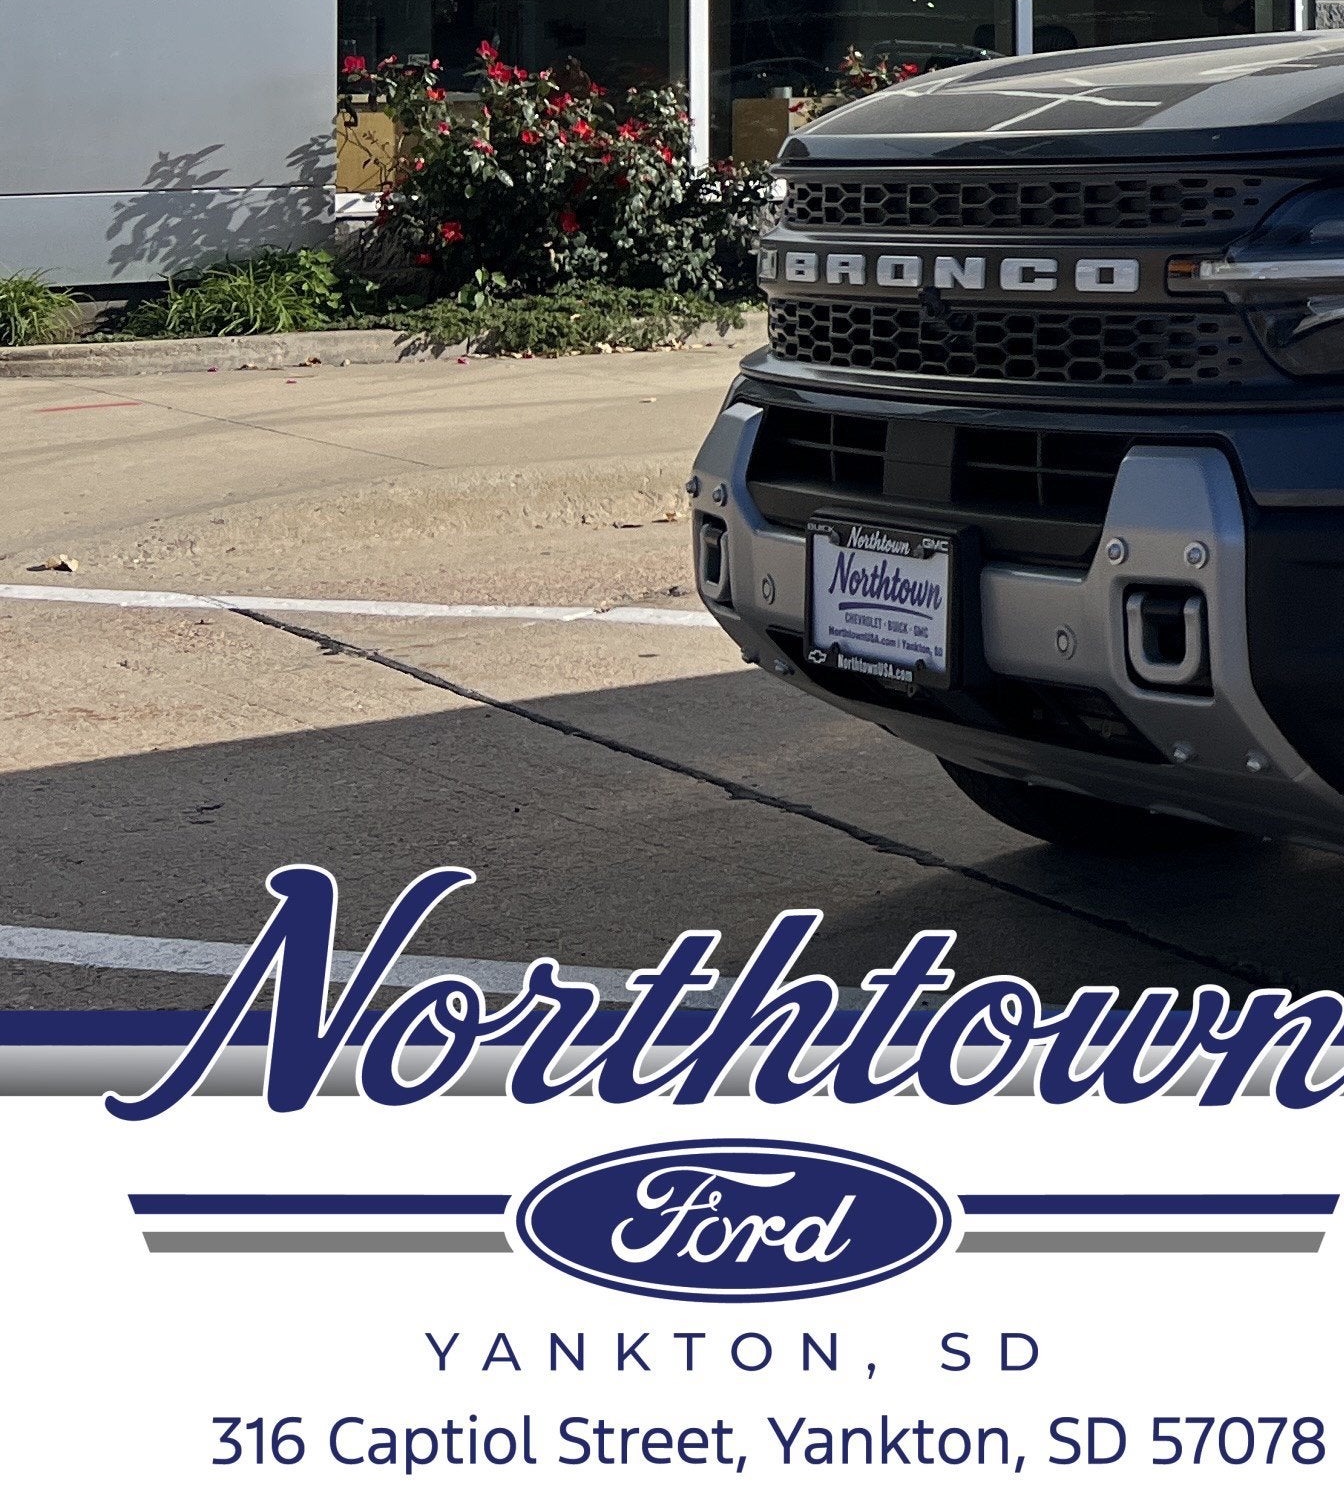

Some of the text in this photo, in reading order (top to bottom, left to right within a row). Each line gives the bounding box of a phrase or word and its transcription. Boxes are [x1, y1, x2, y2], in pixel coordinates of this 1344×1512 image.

[785, 251, 1140, 293] BRONCO
[846, 526, 910, 555] Northtown
[922, 538, 949, 552] GMC
[828, 551, 943, 610] Northtown
[844, 612, 882, 630] CHEVROLET
[837, 653, 913, 683] NorthtownUSA.com
